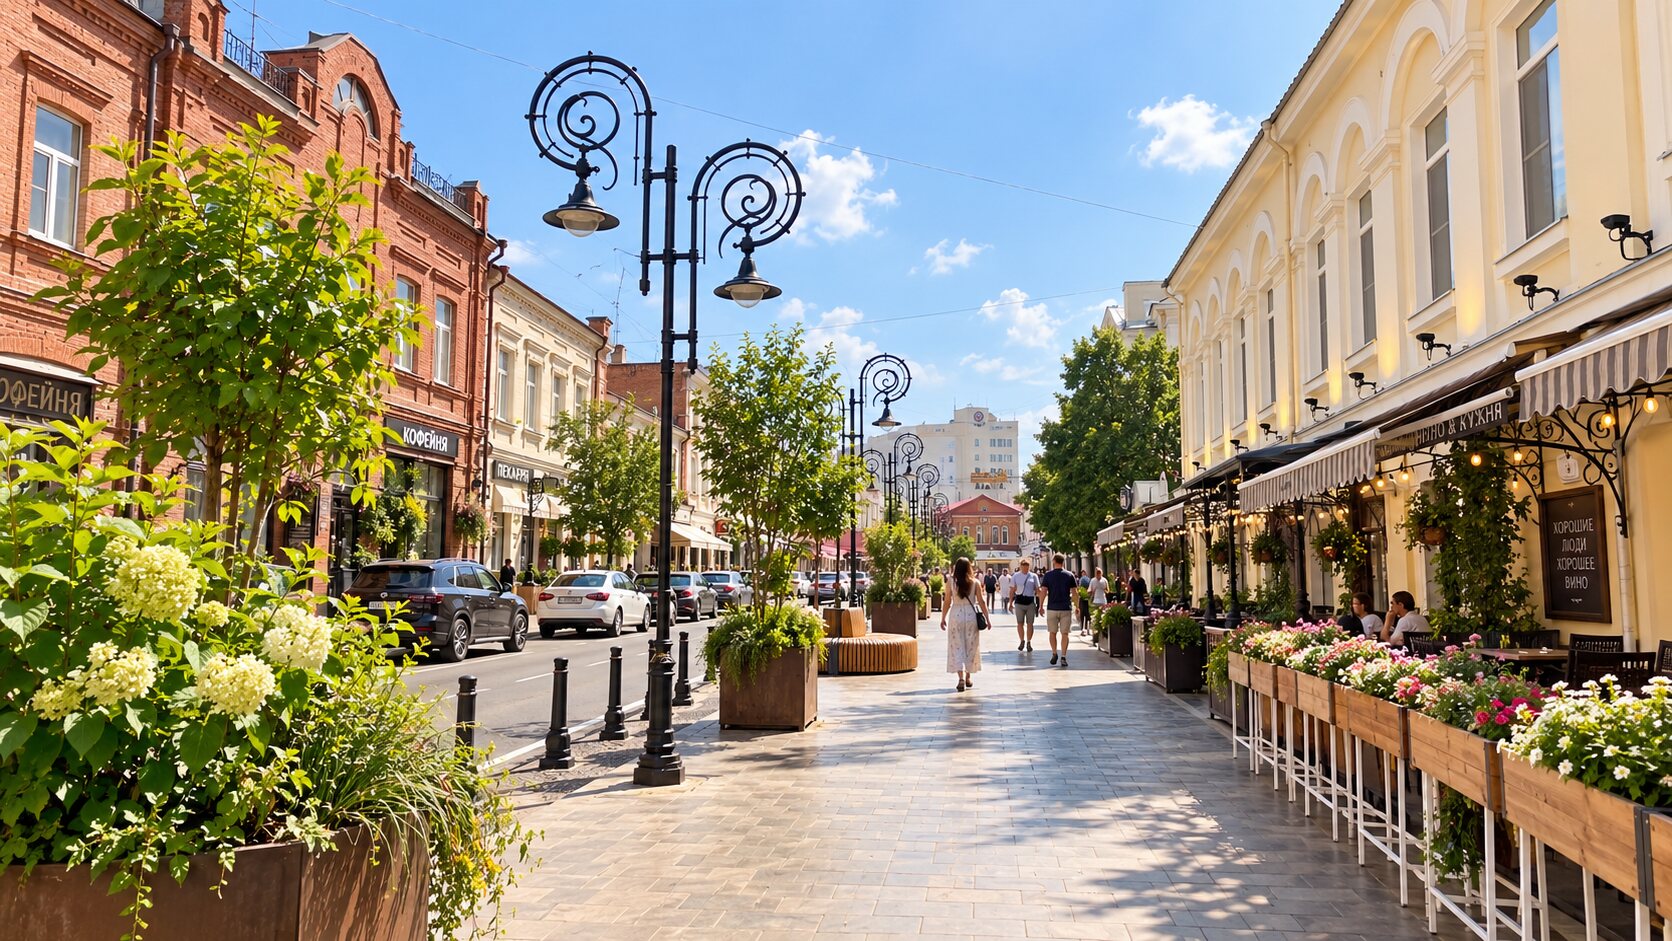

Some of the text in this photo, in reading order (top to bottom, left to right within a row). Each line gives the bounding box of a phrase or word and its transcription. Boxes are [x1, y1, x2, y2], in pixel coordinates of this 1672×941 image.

[403, 426, 448, 452] КОФЕЙНЯ
[1553, 518, 1594, 534] ХОРОШИЕ
[1562, 537, 1587, 553] ЛЮДИ
[1557, 557, 1595, 571] ХОРОШЕЕ
[1565, 576, 1589, 589] ВИНО
